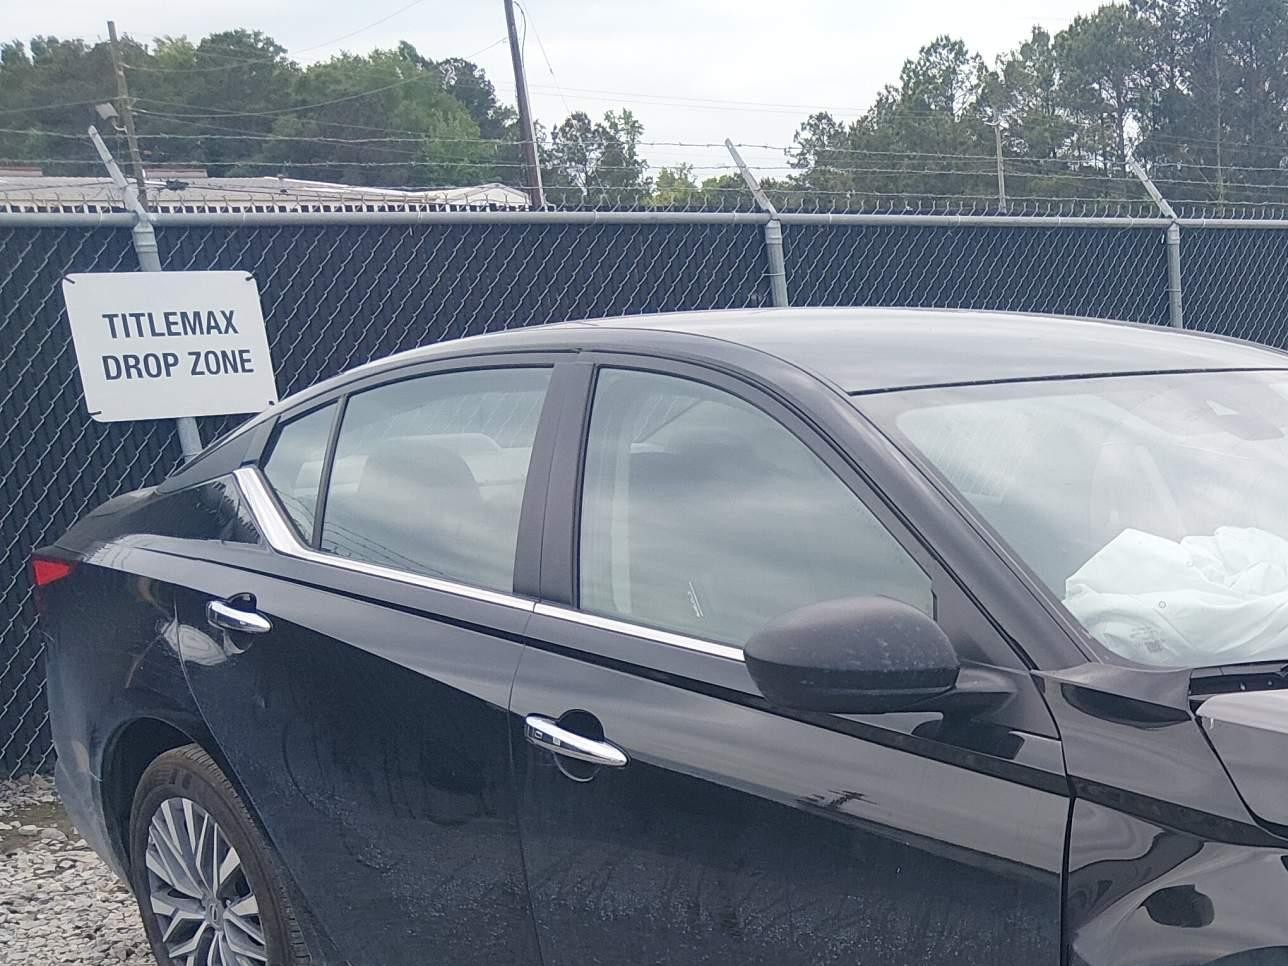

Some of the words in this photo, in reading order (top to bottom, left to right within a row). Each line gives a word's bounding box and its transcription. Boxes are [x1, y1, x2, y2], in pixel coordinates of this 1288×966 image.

[102, 310, 239, 339] TITLEMAX
[102, 352, 180, 381] DROP
[188, 349, 255, 376] ZONE
